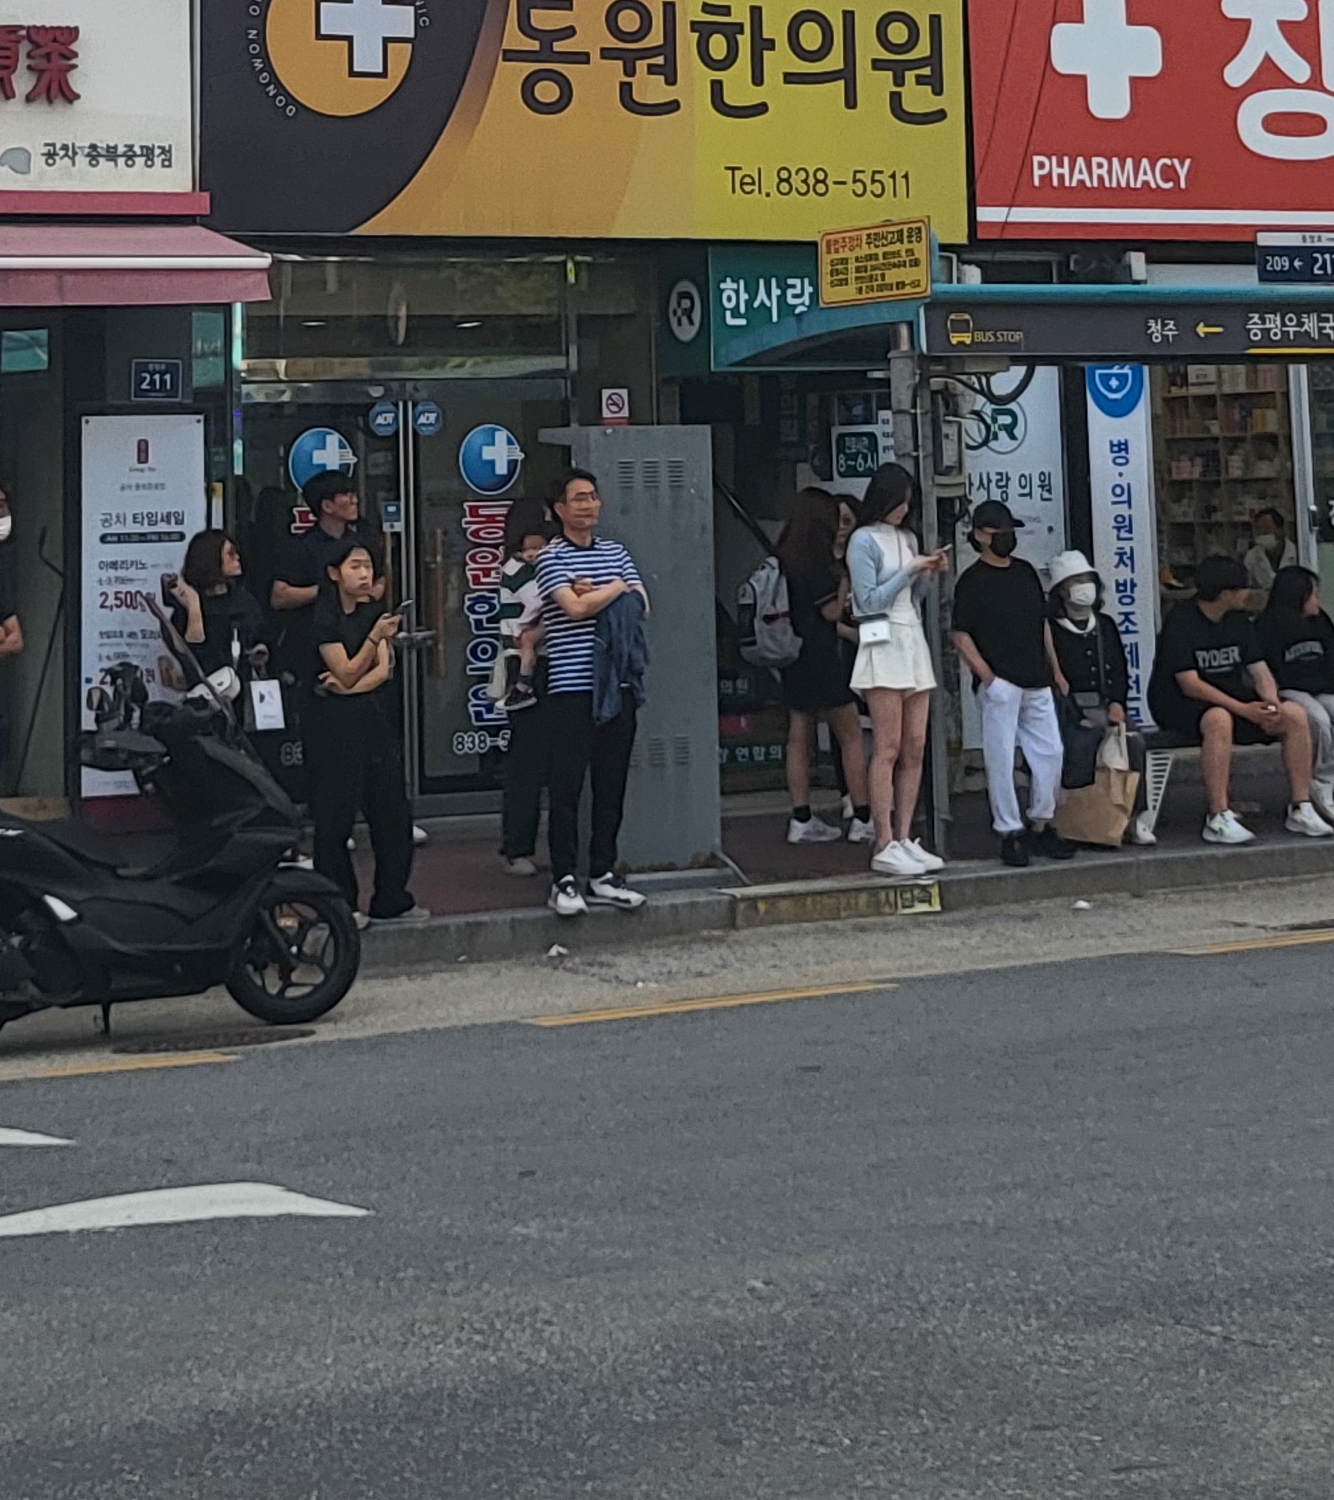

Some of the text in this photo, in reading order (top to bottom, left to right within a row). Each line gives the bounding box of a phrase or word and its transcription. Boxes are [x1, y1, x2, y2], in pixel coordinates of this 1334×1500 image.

[247, 28, 296, 117] DONGWON
[40, 142, 80, 168] 공차
[1031, 154, 1193, 191] PHARMACY
[1265, 255, 1290, 271] 209
[973, 331, 995, 343] BUS
[1146, 318, 1180, 344] 청주
[139, 372, 172, 390] 211
[374, 412, 395, 426] ADT
[417, 412, 439, 426] ADT
[967, 470, 1054, 503] 사랑 의원
[99, 510, 186, 529] 공차 타임세일
